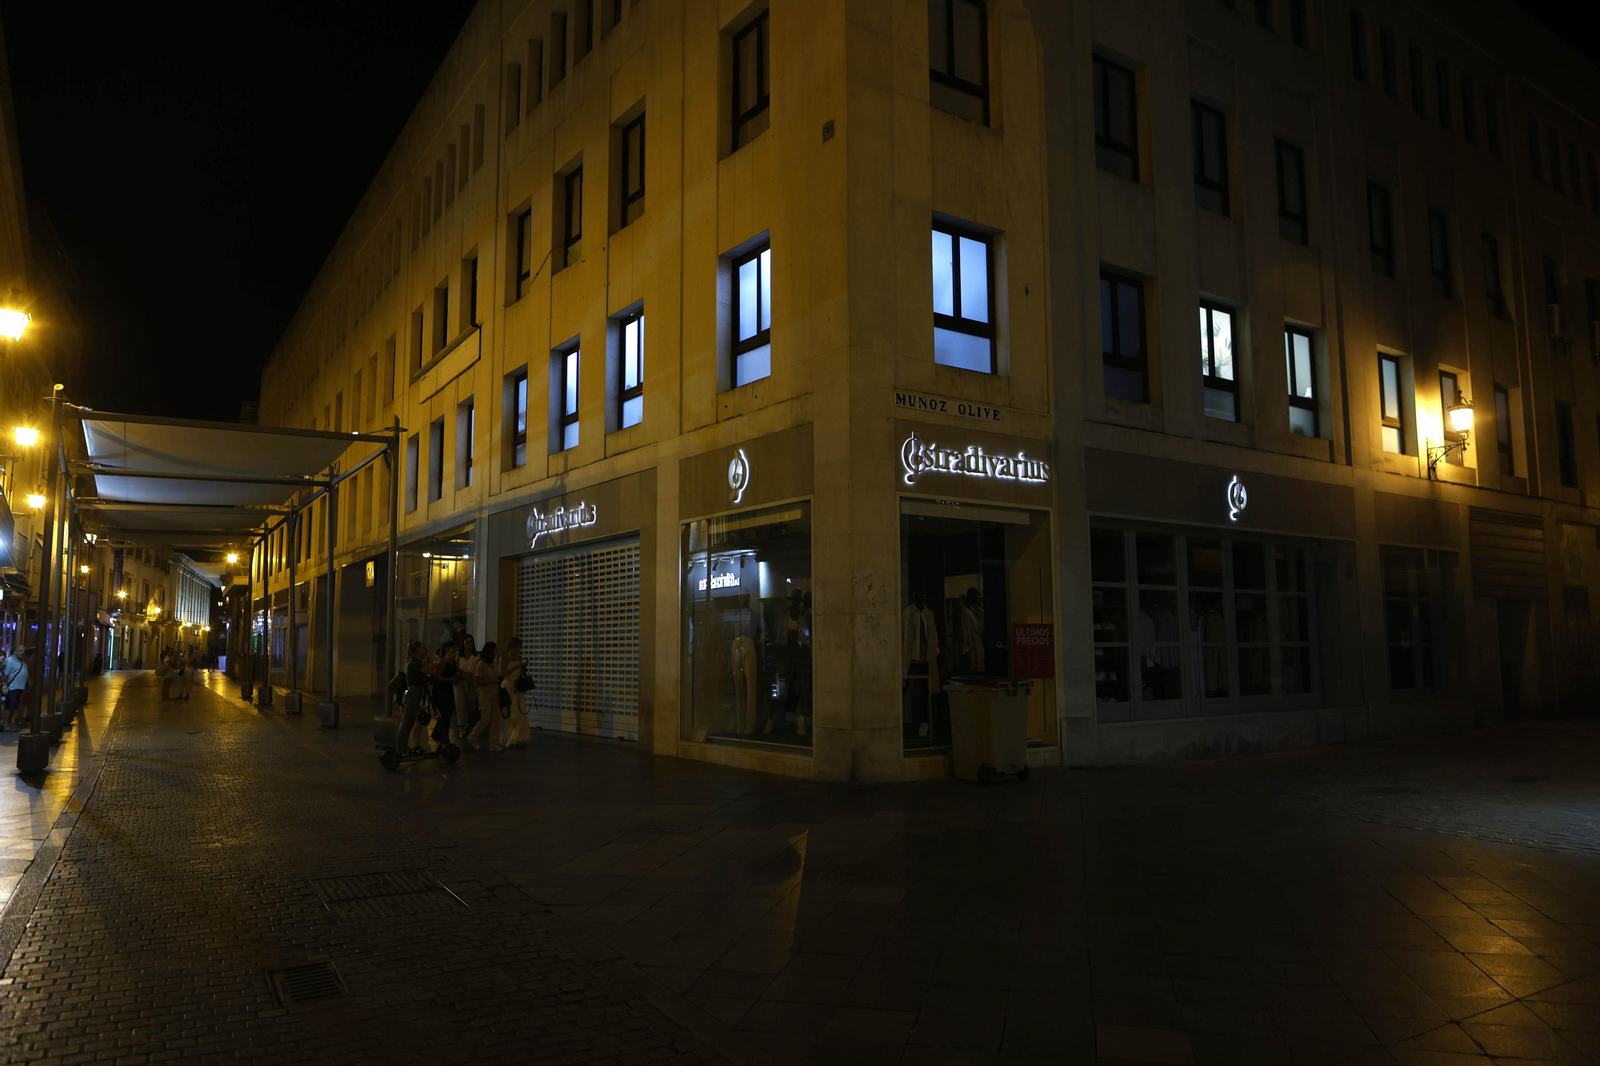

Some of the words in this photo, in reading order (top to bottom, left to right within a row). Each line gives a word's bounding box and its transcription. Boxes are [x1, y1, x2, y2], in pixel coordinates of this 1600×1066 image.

[895, 392, 947, 412] MUÑOZ
[958, 403, 1000, 421] OLIVE
[1015, 626, 1050, 637] ÚLTIMOS
[1016, 637, 1050, 646] PRECIOS
